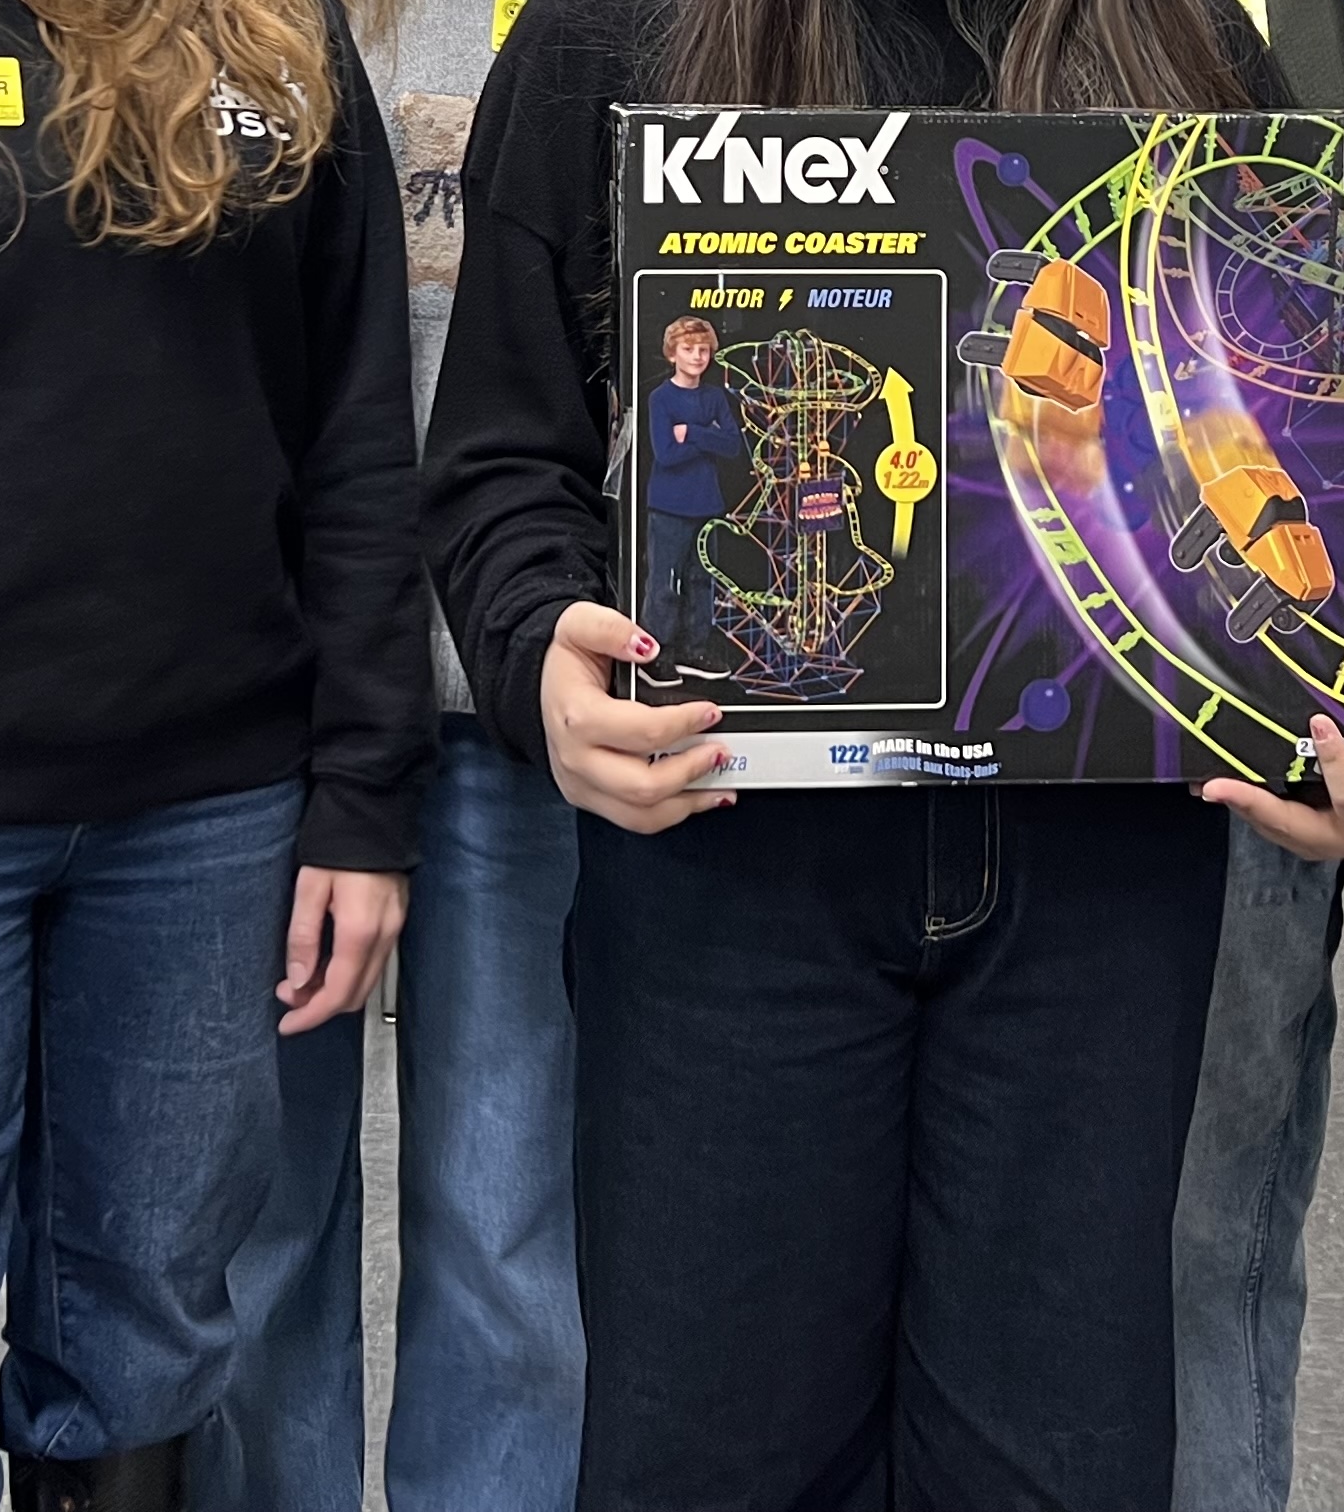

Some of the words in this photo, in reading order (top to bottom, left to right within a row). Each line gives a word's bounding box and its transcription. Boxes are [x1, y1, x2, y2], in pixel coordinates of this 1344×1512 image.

[658, 231, 779, 255] ATOMIC
[784, 231, 920, 255] COASTER
[690, 288, 766, 309] MOTOR
[807, 288, 893, 309] MOTEUR
[883, 471, 930, 490] 1.22m
[828, 744, 870, 764] 1222
[872, 738, 915, 756] MADE
[934, 742, 961, 759] the
[962, 742, 994, 760] USA
[1299, 740, 1309, 753] 2
